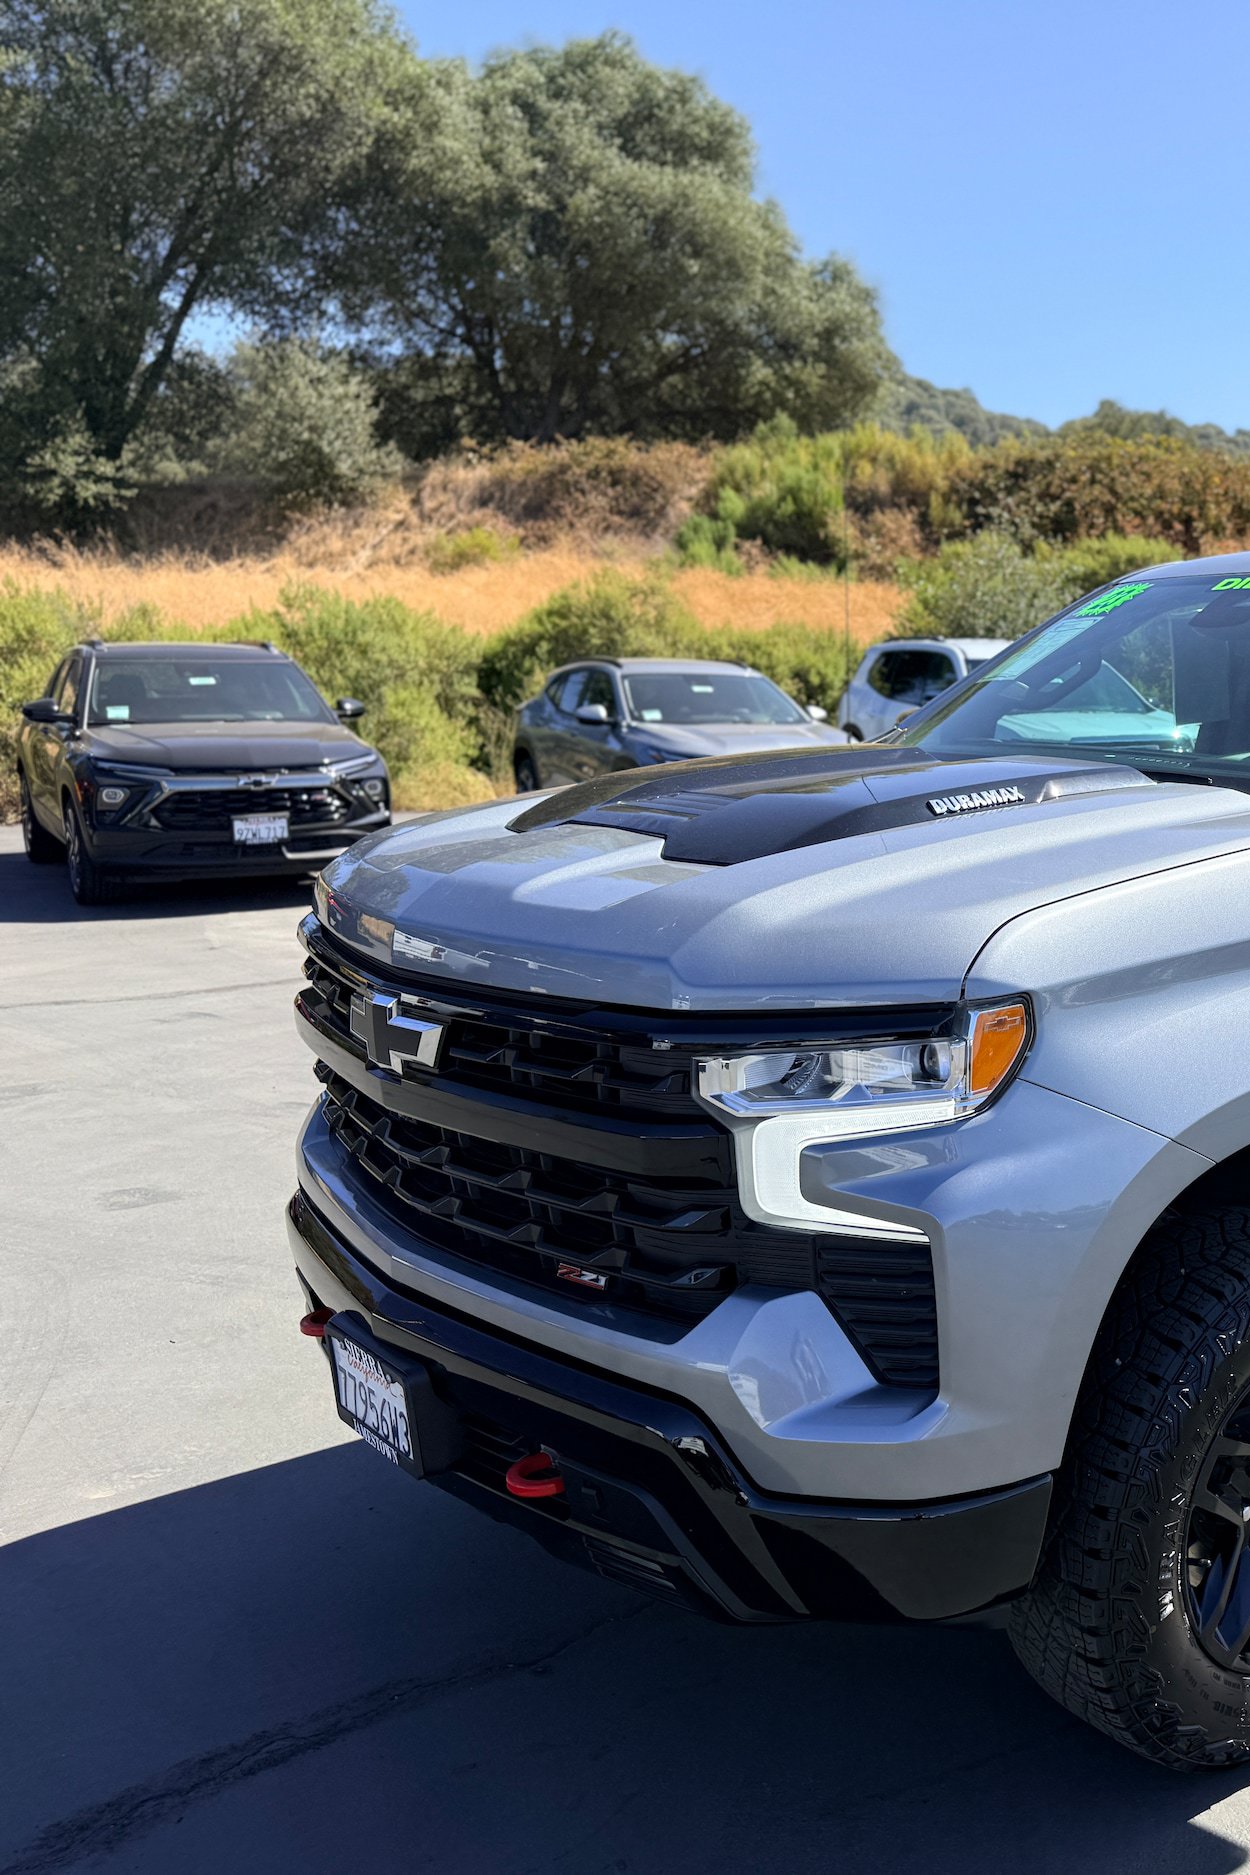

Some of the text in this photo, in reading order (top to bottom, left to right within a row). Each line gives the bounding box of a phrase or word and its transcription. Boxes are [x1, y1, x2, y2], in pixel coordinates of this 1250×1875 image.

[926, 786, 1025, 815] DURAMAX
[557, 1262, 607, 1290] Z71
[343, 1338, 388, 1382] SIERRA
[338, 1364, 412, 1458] 77956W3
[352, 1417, 399, 1466] JAMESTOWN
